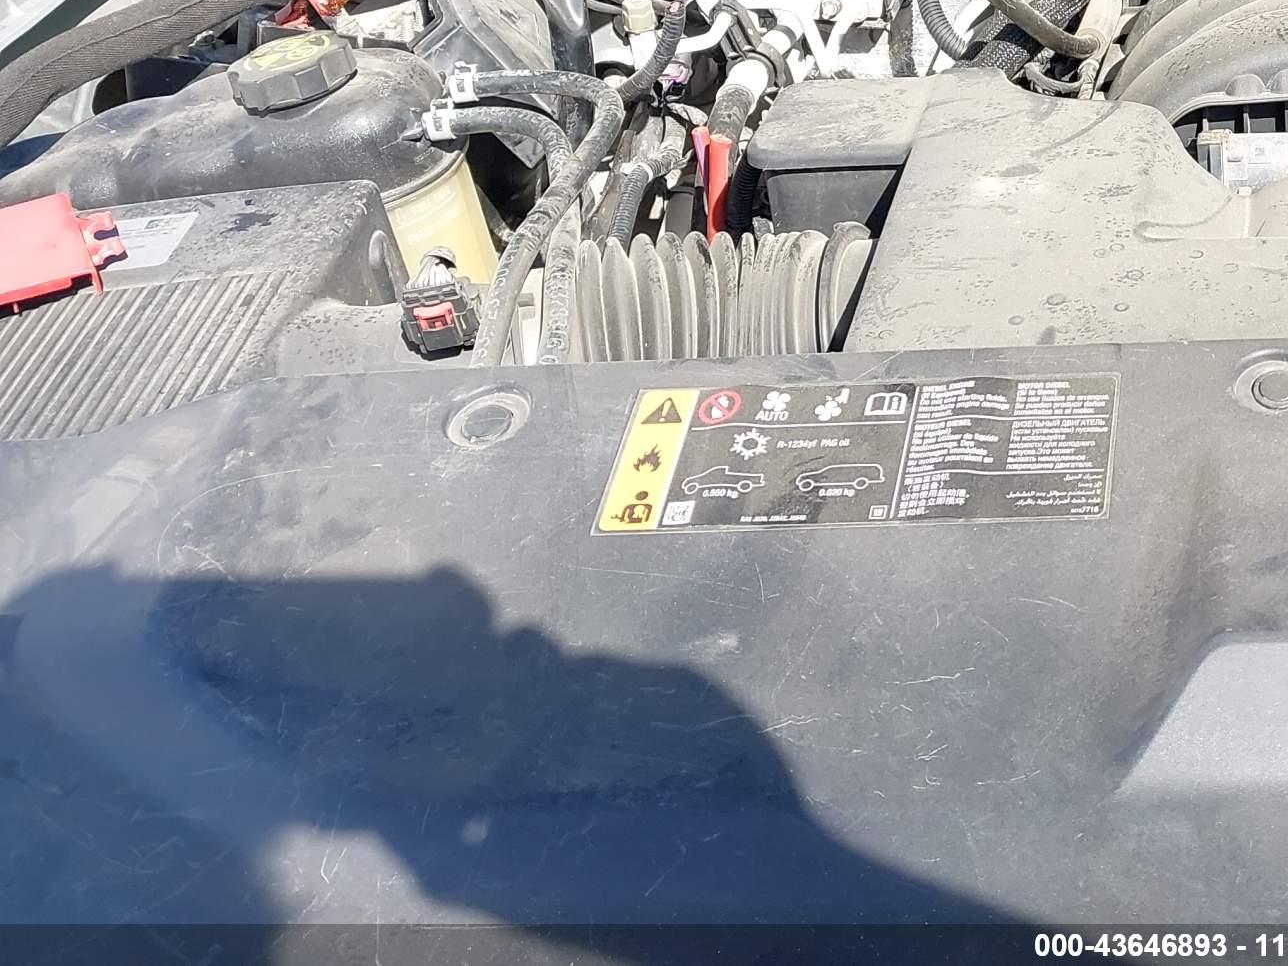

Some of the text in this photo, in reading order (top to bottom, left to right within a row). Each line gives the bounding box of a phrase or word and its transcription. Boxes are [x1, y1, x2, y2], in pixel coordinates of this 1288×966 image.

[755, 410, 789, 421] AUTO
[1061, 418, 1106, 427] ДВИГАТЕЛЬ
[776, 438, 818, 449] R-1234yf
[821, 439, 838, 447] PAG
[726, 488, 738, 499] kg
[843, 487, 855, 498] kg
